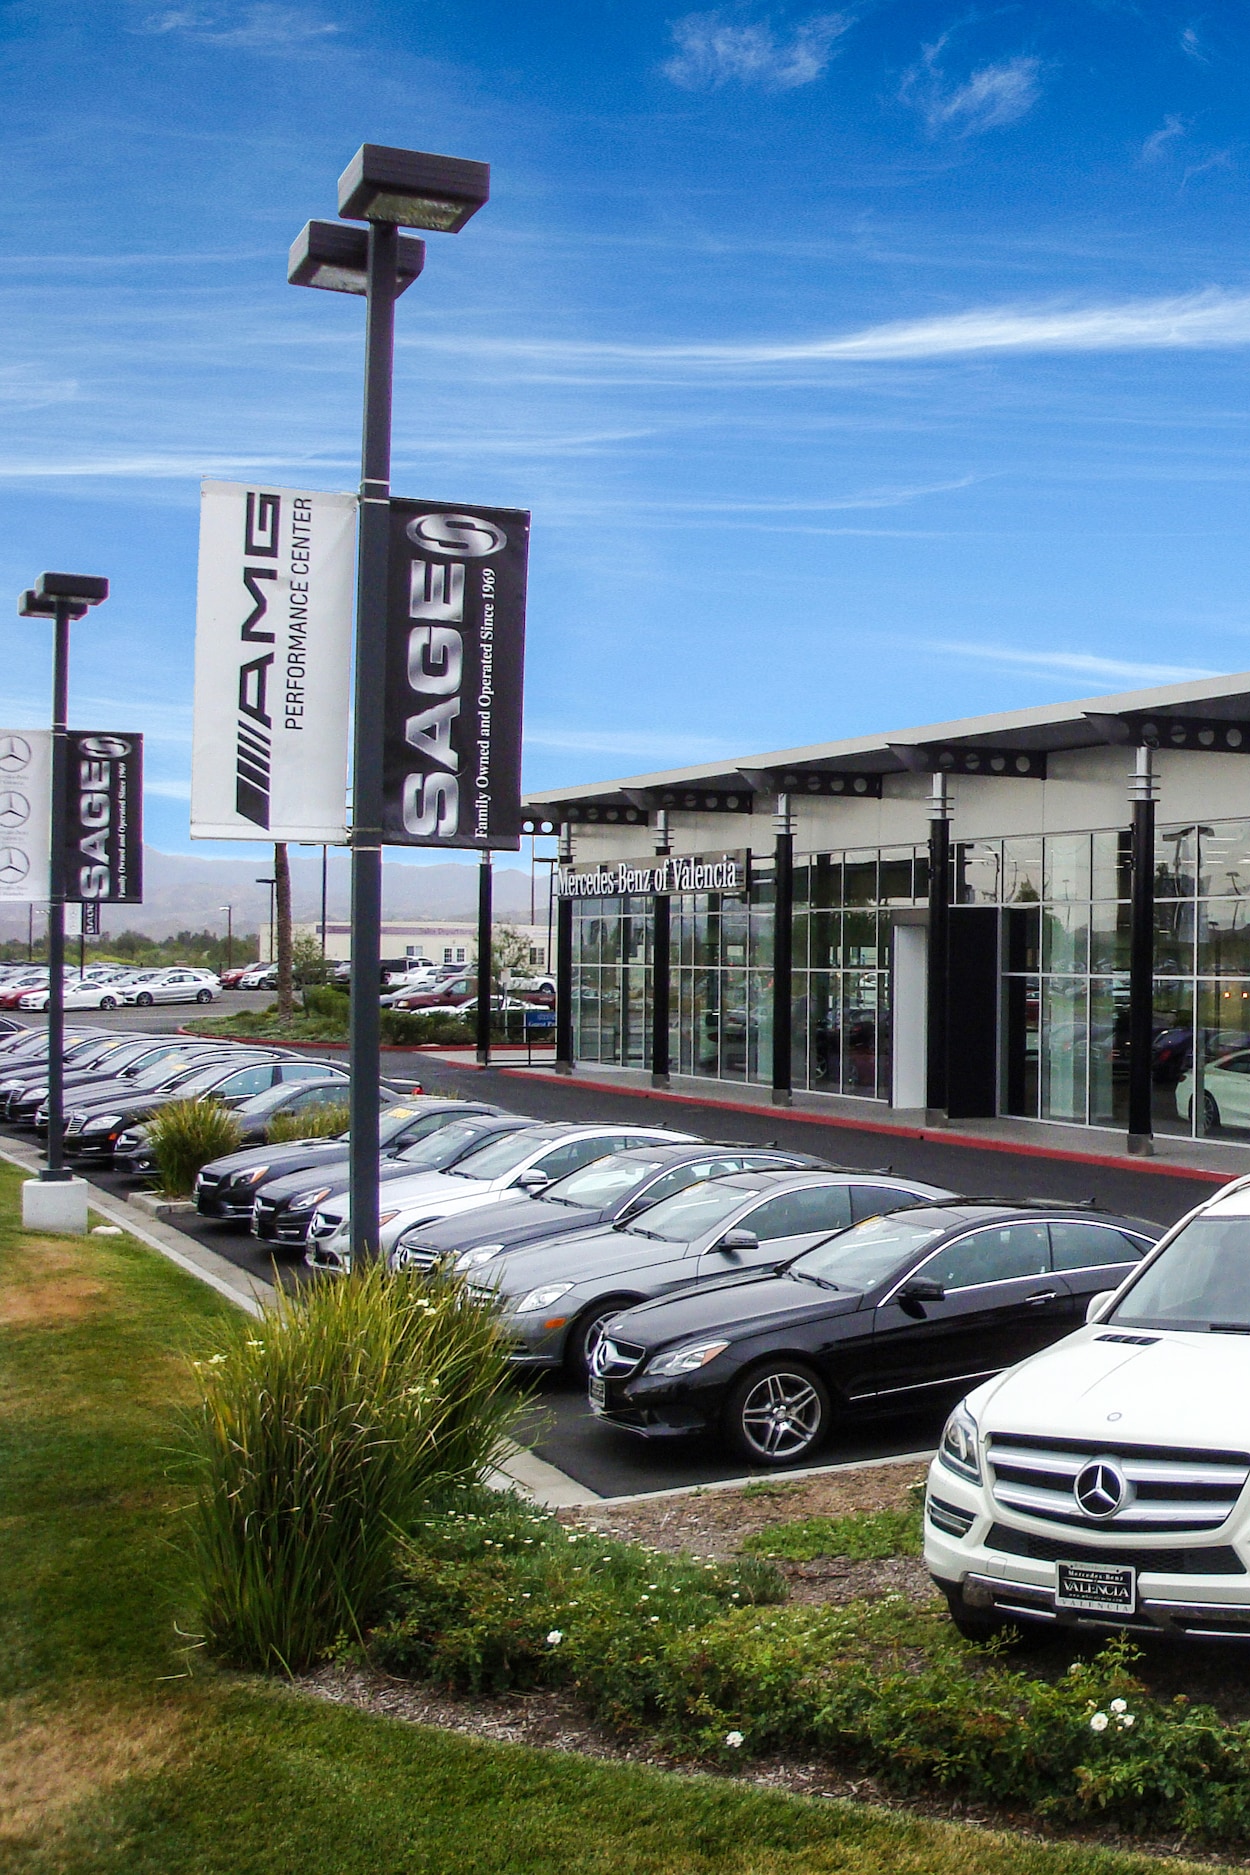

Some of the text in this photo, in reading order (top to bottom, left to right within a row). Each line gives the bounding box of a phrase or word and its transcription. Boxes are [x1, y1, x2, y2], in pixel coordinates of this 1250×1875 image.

[237, 491, 281, 731] AMG
[285, 498, 312, 730] PERFORMANCE CENTER
[403, 559, 466, 838] SAGE
[474, 568, 496, 839] Family Owned and Operated Since 1969
[117, 780, 127, 800] Since
[79, 760, 110, 898] SAGE
[117, 800, 128, 833] Operated
[117, 833, 126, 848] and
[117, 848, 126, 873] Owned
[558, 854, 737, 897] Mercedes-Benz of Valencia
[117, 875, 128, 898] Family
[1061, 1599, 1129, 1612] VALENCIA
[1063, 1580, 1129, 1598] VALENCIA
